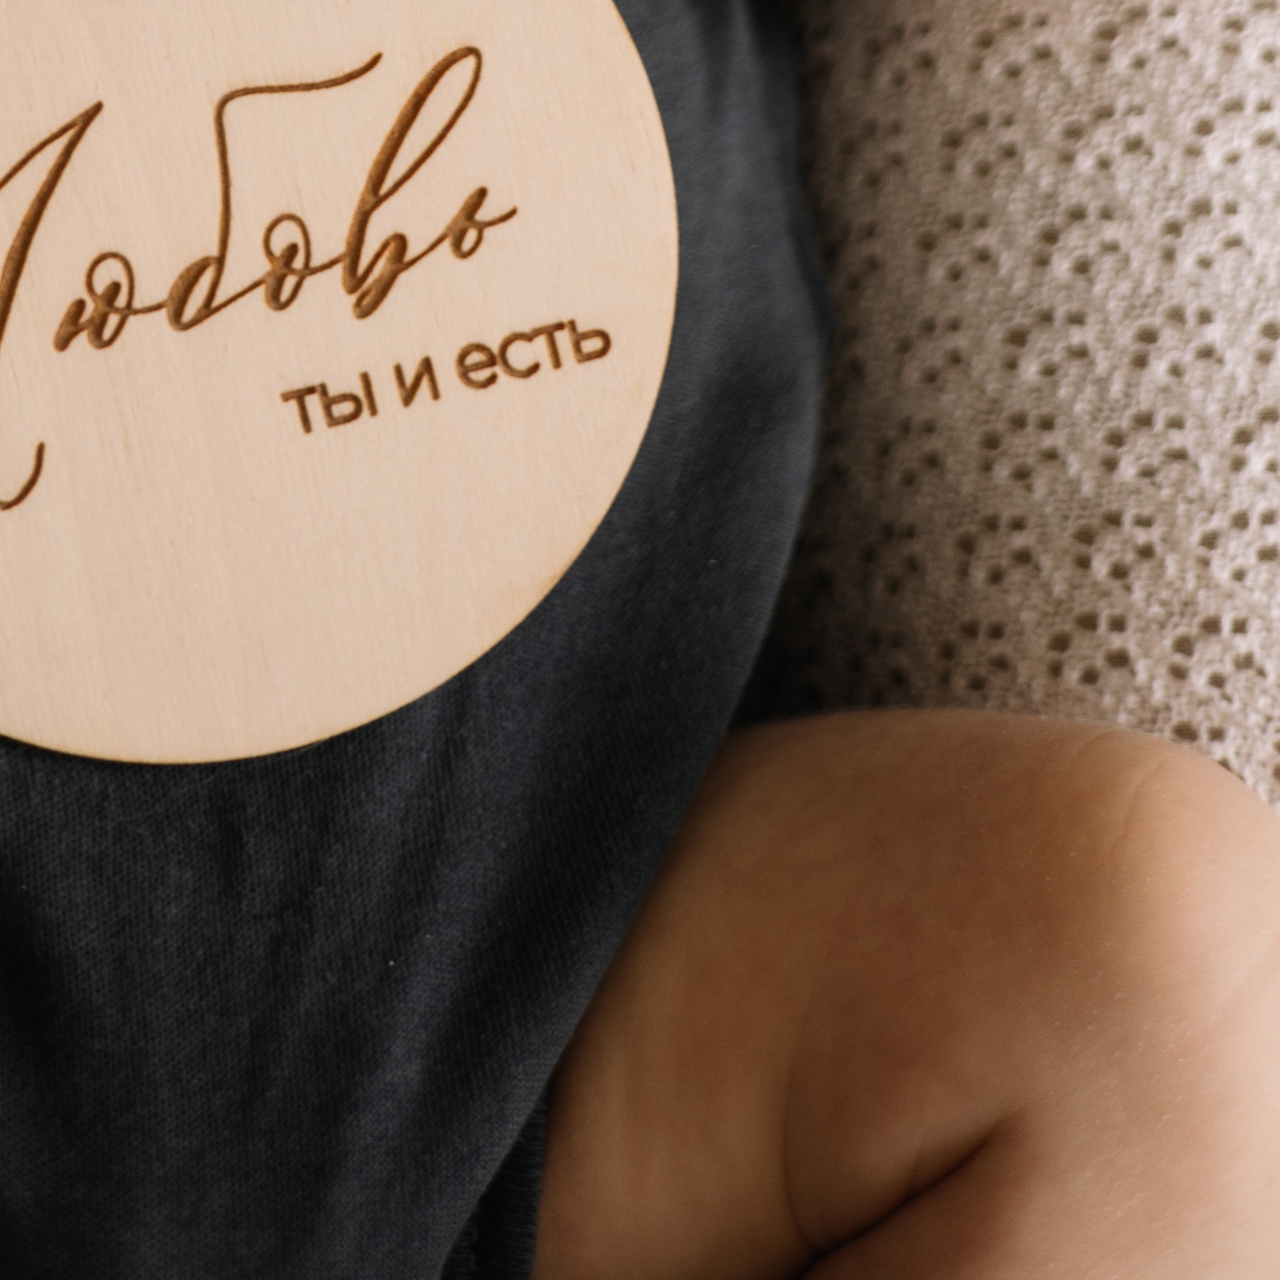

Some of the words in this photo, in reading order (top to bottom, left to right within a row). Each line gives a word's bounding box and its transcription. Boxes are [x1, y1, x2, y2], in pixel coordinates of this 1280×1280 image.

[279, 371, 379, 433] ты
[392, 356, 441, 408] и
[454, 319, 612, 390] есть
